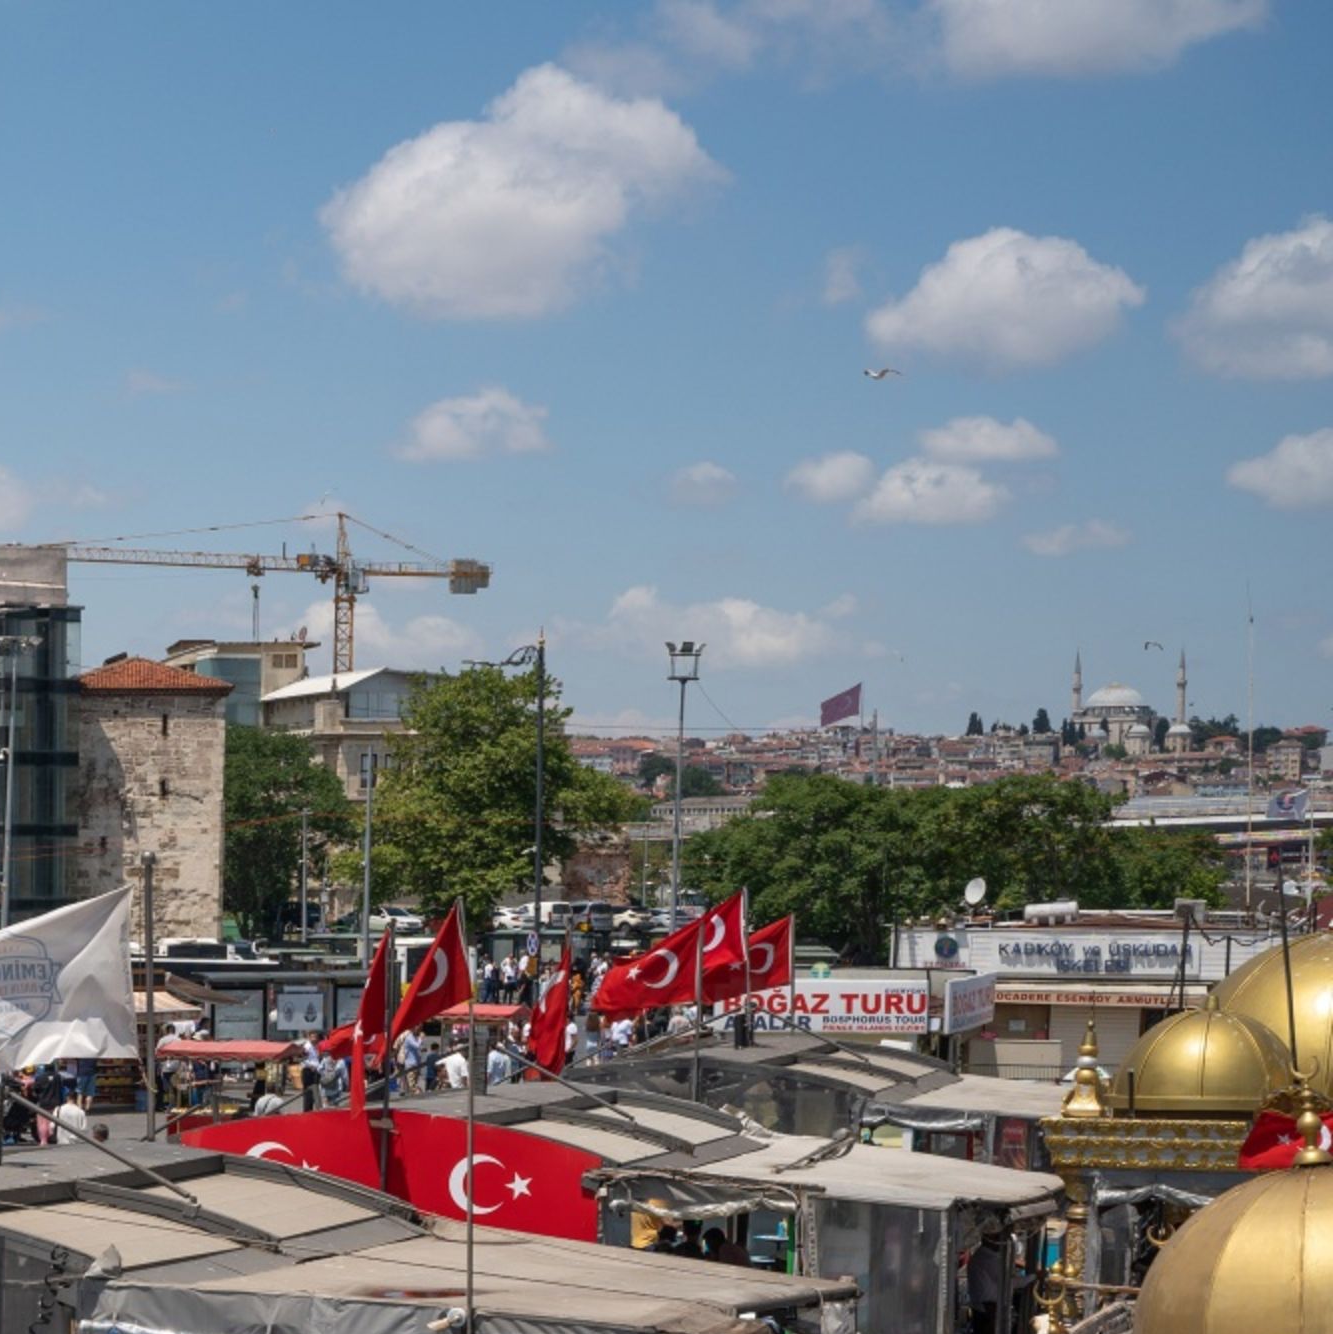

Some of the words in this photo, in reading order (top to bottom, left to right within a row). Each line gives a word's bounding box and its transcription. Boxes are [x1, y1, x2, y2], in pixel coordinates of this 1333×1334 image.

[998, 939, 1074, 957] KADIKÖY
[723, 989, 830, 1015] BOĞAZ
[840, 993, 927, 1015] TURU
[724, 1016, 811, 1031] AALAR
[822, 1015, 892, 1024] BOSPHORUS
[895, 1015, 926, 1024] TOUR
